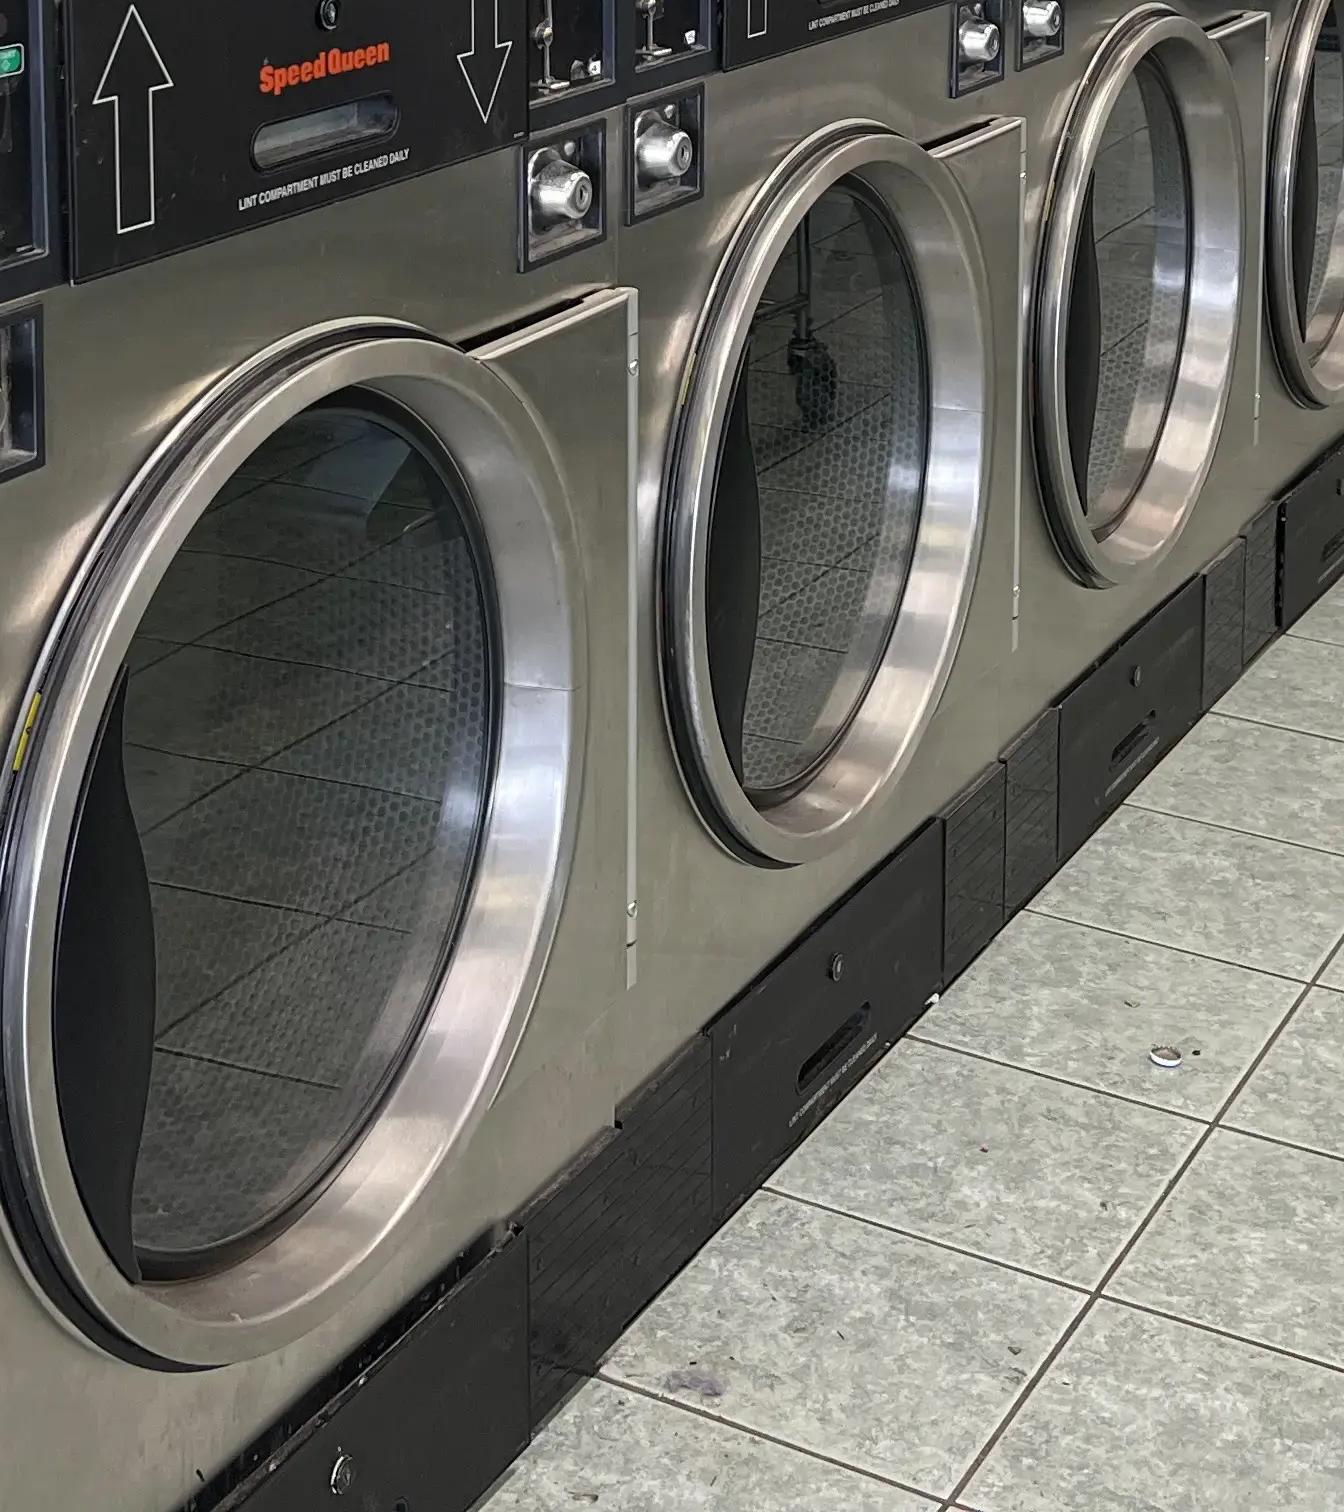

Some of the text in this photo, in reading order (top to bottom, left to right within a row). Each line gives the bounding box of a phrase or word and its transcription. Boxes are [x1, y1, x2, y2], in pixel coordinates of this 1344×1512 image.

[259, 42, 390, 95] Speed Queen
[239, 148, 410, 211] LINT COMPARTMENT MUST BE CLEANED DAILY
